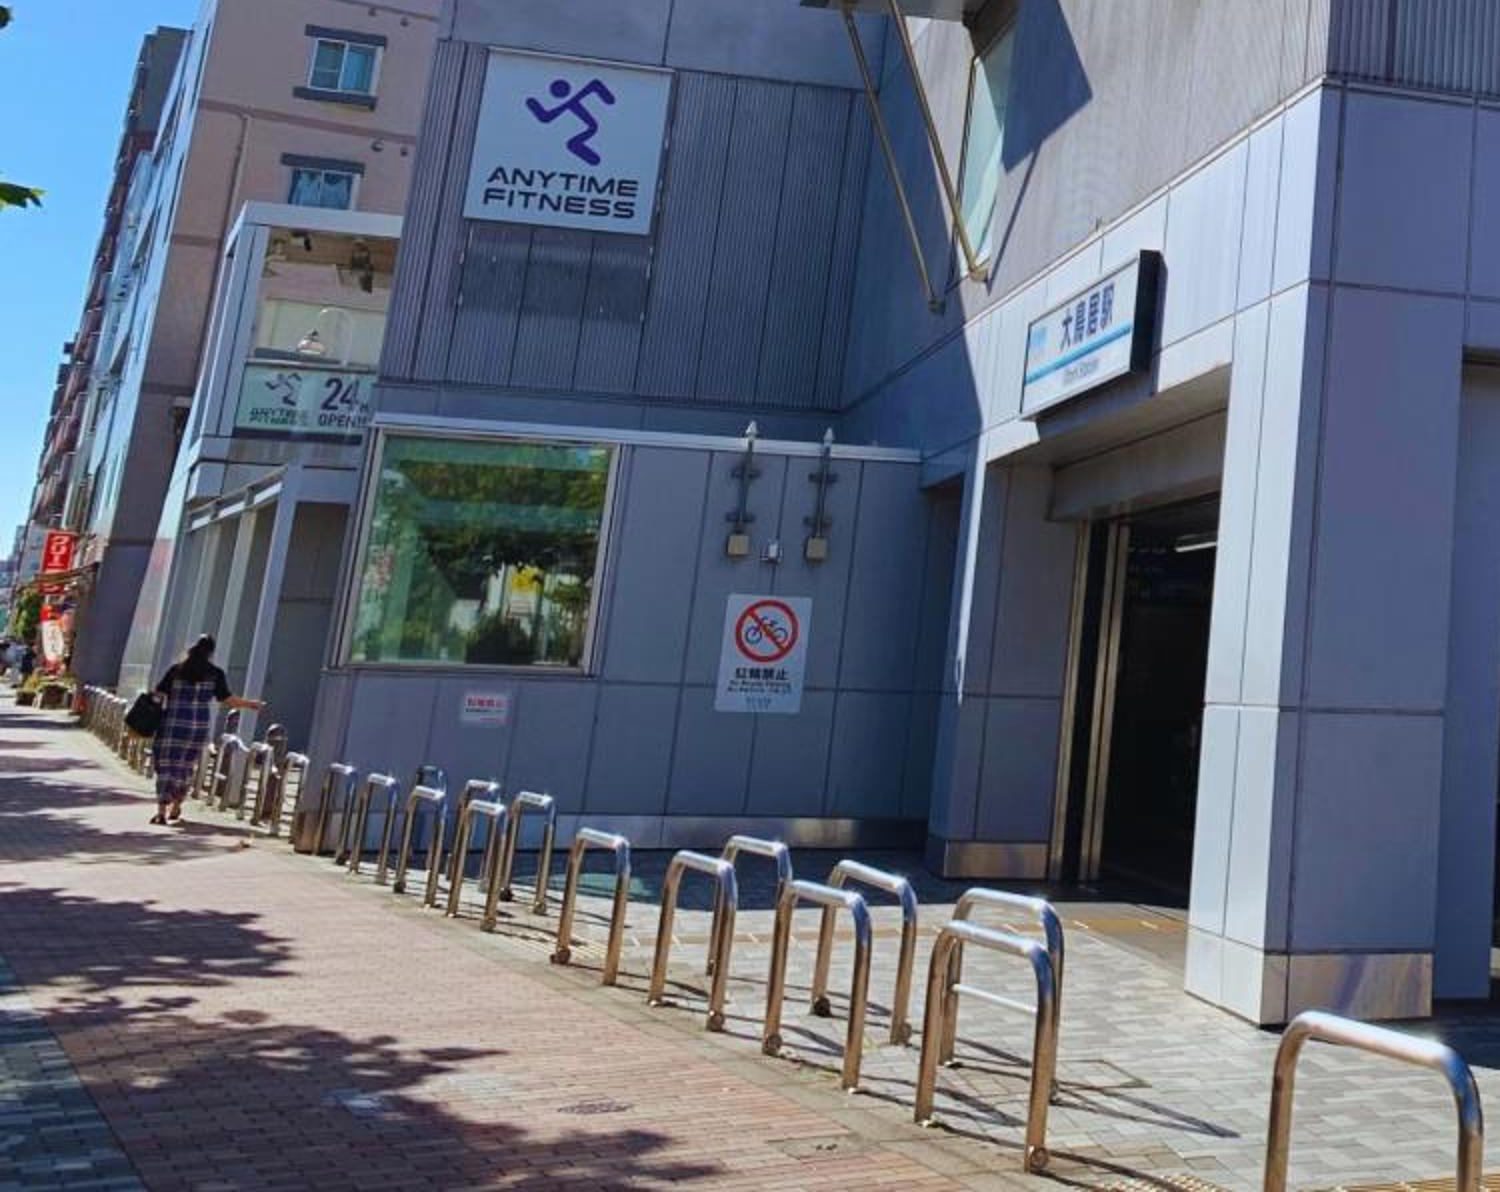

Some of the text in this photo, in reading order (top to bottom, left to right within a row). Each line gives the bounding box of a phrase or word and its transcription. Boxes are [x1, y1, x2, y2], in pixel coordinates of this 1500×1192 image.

[486, 166, 639, 198] ANYTIME
[482, 187, 636, 220] FITNESS
[1061, 283, 1114, 351] 大鳥居駅
